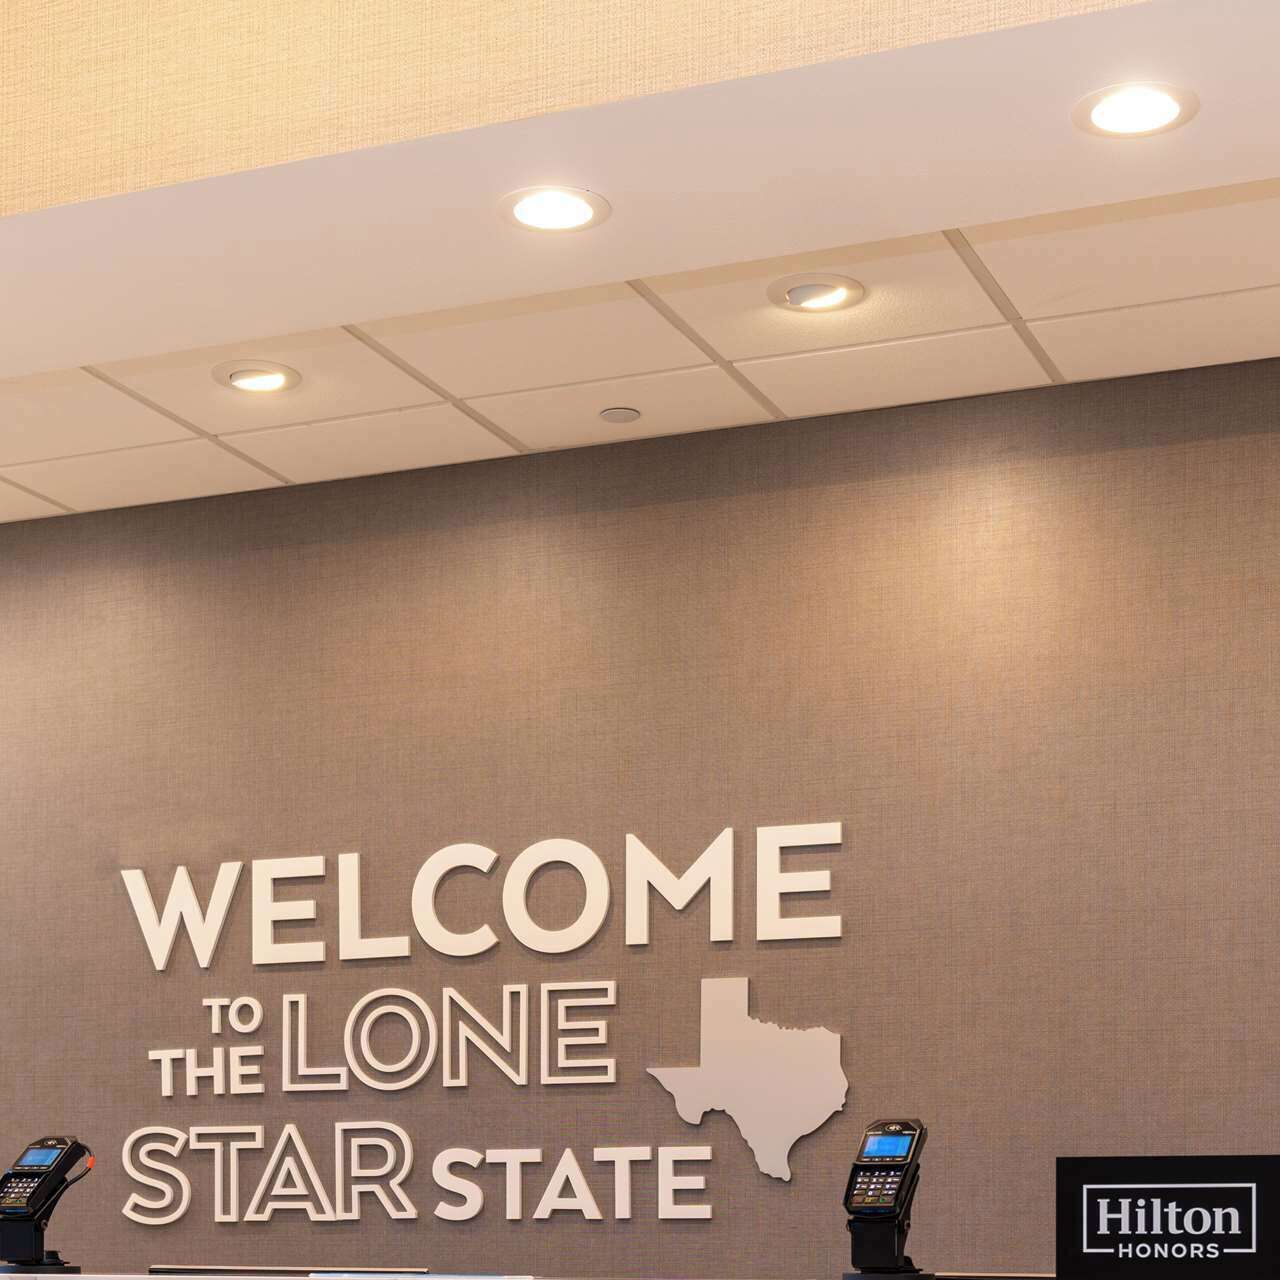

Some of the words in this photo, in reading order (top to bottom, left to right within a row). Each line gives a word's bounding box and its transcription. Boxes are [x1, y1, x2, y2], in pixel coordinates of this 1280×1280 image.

[121, 822, 842, 971] WELCOME
[148, 1046, 265, 1098] THE
[281, 980, 617, 1092] LONE
[202, 996, 264, 1035] TO
[121, 1121, 418, 1226] STAR
[431, 1146, 713, 1222] STATE
[1096, 1198, 1242, 1235] Hilton
[1118, 1243, 1220, 1258] HONORS
